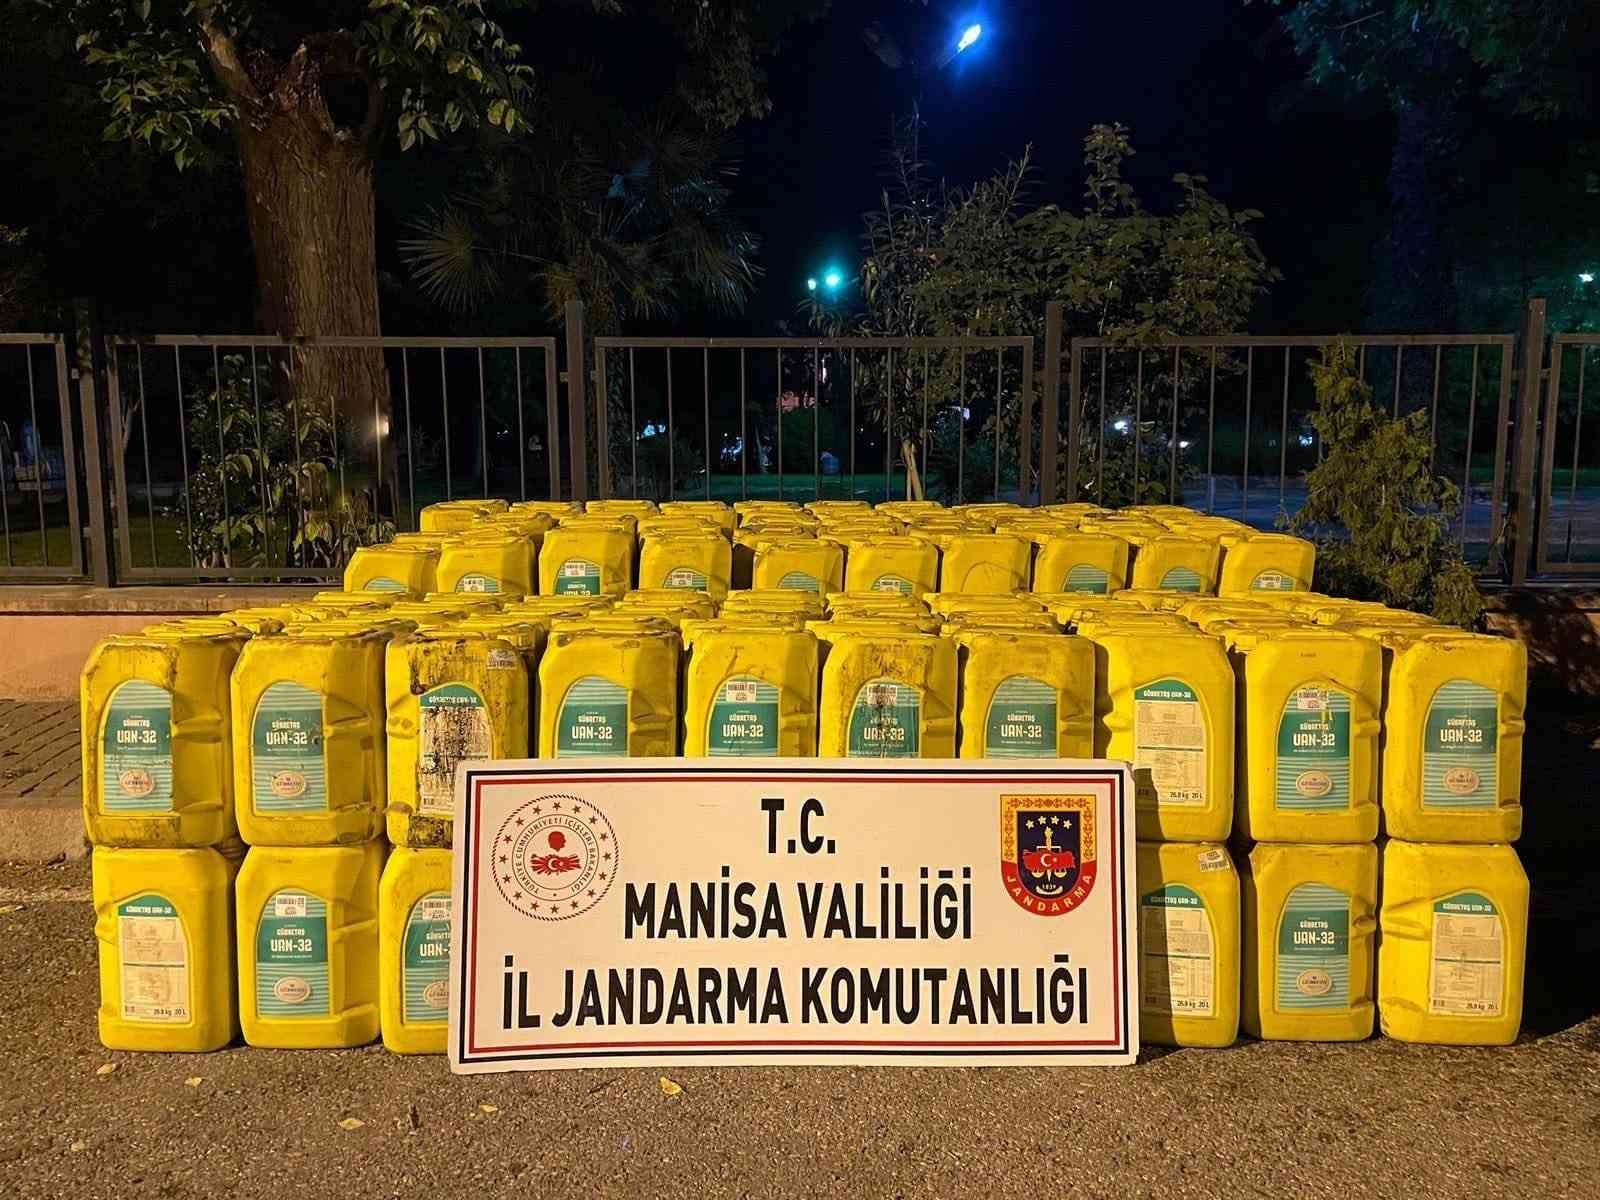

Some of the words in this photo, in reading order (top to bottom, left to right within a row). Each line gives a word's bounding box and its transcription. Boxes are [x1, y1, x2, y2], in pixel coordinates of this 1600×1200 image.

[117, 730, 157, 744] UAN-32
[572, 726, 613, 739] UAN-32
[722, 725, 764, 737] UAN-32
[1001, 725, 1042, 738] UAN-32
[1440, 729, 1483, 742] UAN-32
[266, 731, 308, 745] UAN-32
[1293, 733, 1336, 746] UAN-32
[762, 799, 835, 854] T.C.
[1007, 875, 1092, 912] JANDARMA
[625, 865, 787, 939] MANİSA
[798, 866, 971, 940] VALİLİĞİ
[1293, 931, 1335, 944] UAN-32
[270, 939, 313, 952] UAN-32
[503, 955, 541, 1030] İL
[552, 967, 789, 1028] JANDARMA
[801, 954, 1089, 1026] KOMUTANLIĞI
